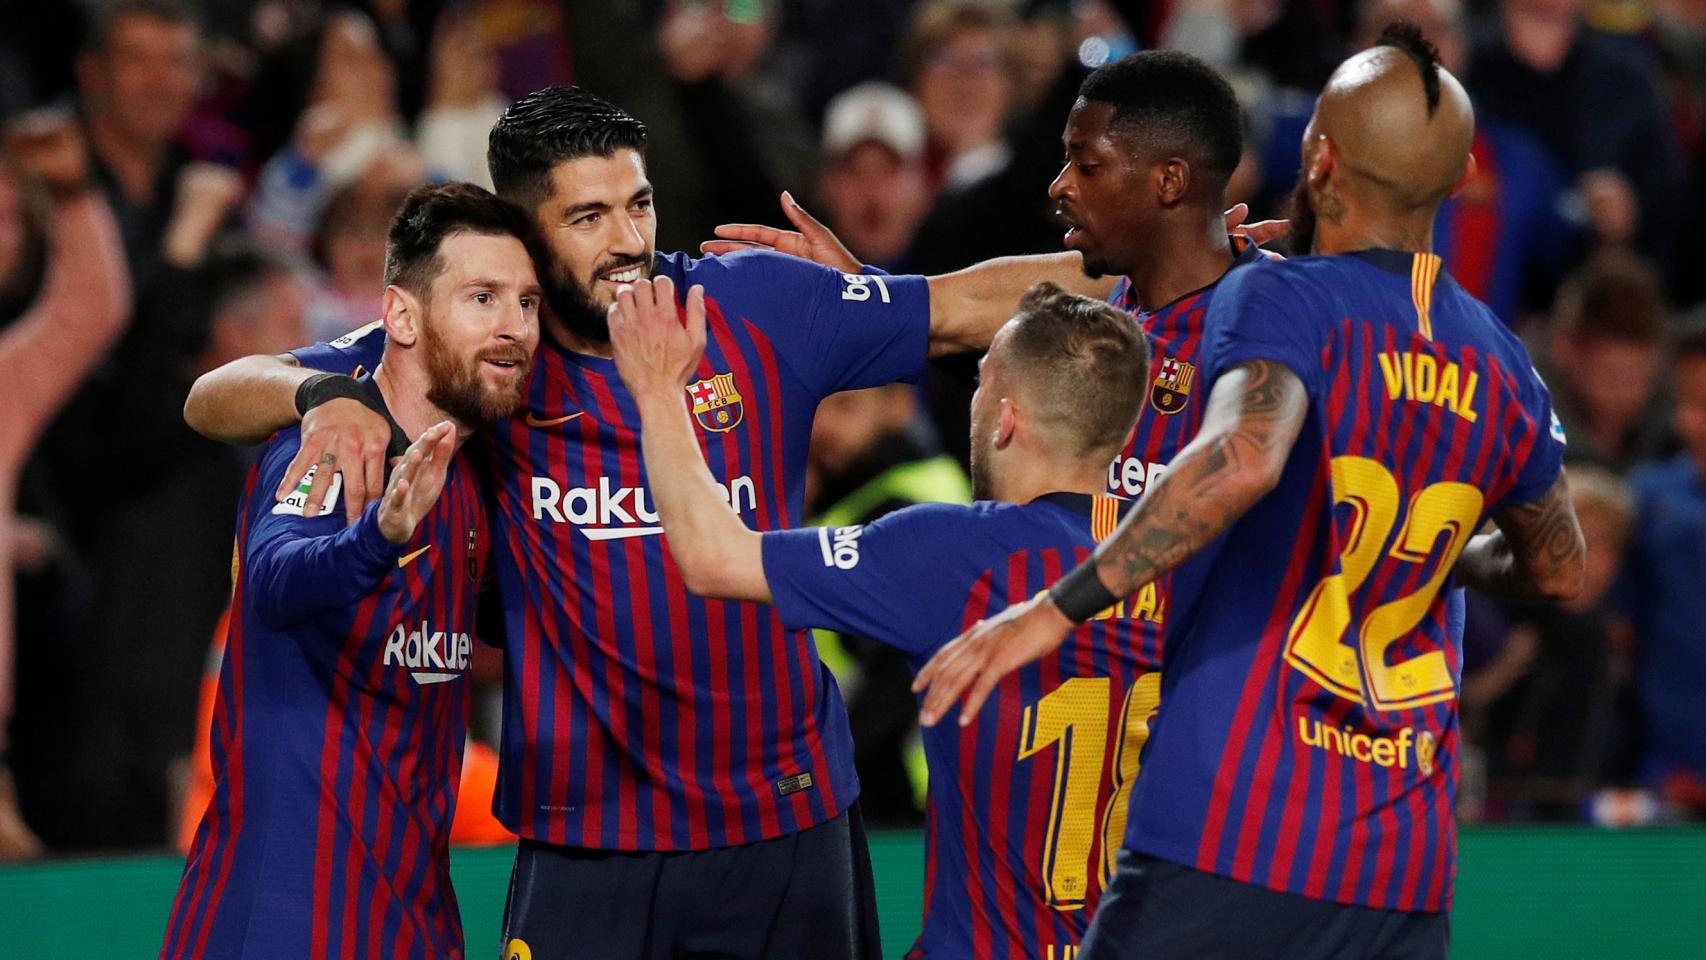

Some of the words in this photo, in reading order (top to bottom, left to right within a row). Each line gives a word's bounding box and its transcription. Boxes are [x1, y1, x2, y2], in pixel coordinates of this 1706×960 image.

[707, 397, 728, 409] FCB
[1377, 350, 1479, 424] VIDAL
[531, 475, 757, 525] Rakun
[1283, 455, 1484, 712] 22
[1299, 716, 1413, 768] unicef
